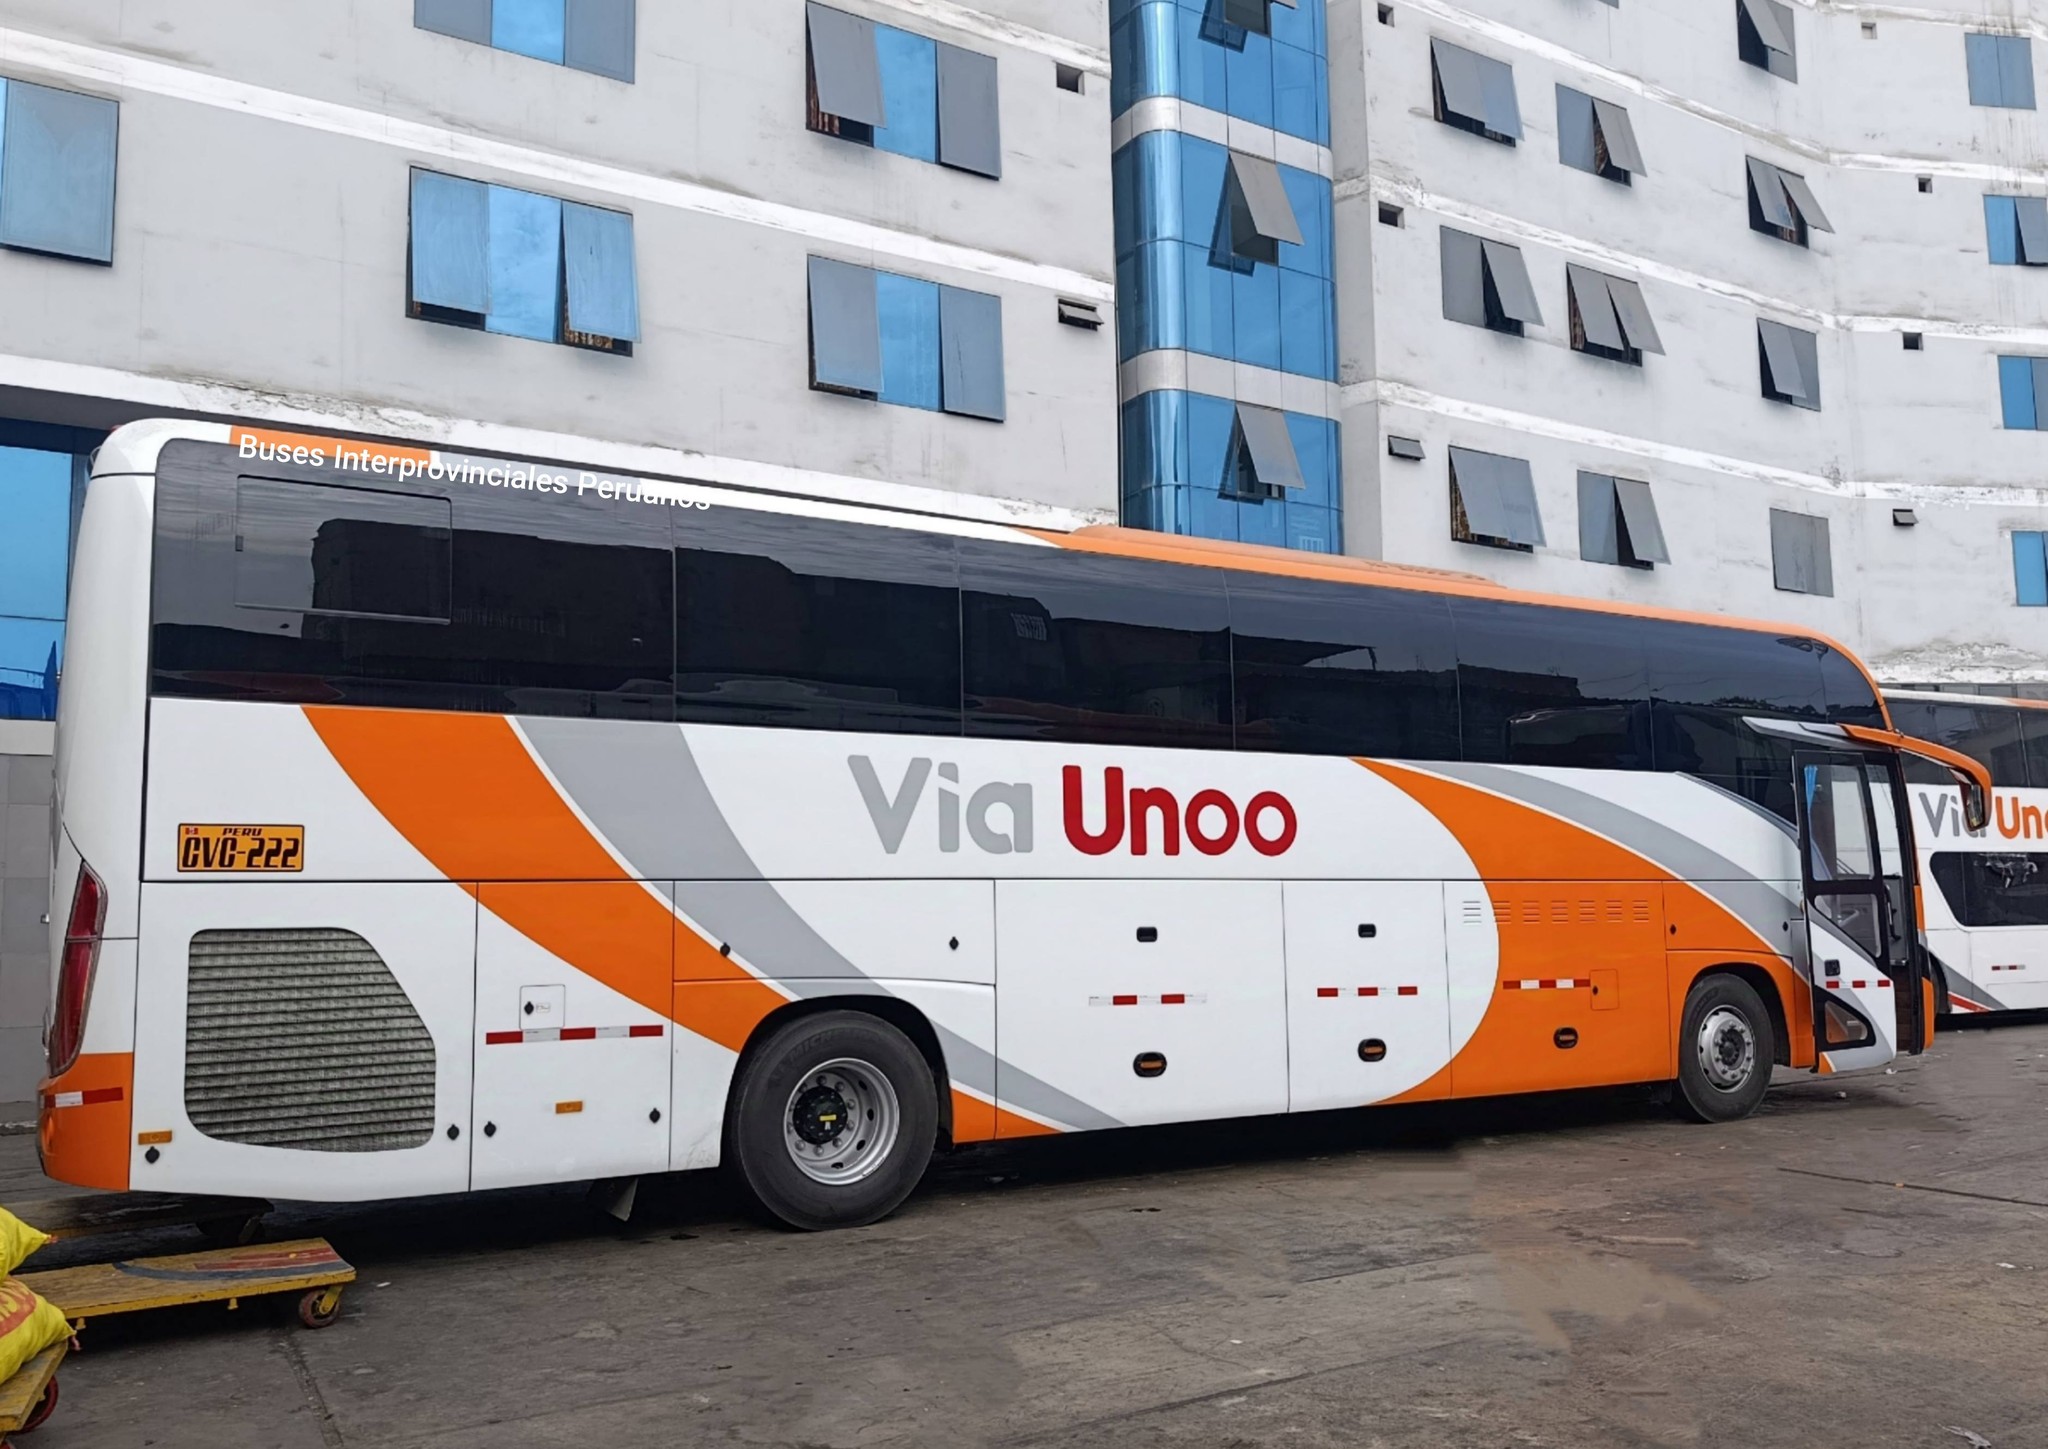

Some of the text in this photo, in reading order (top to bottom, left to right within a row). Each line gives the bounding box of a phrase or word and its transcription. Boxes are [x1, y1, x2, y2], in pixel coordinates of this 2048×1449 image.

[846, 754, 1298, 857] Via Unoo
[1995, 796, 2048, 840] Un
[222, 827, 263, 837] PERU
[181, 836, 300, 869] CVC-222
